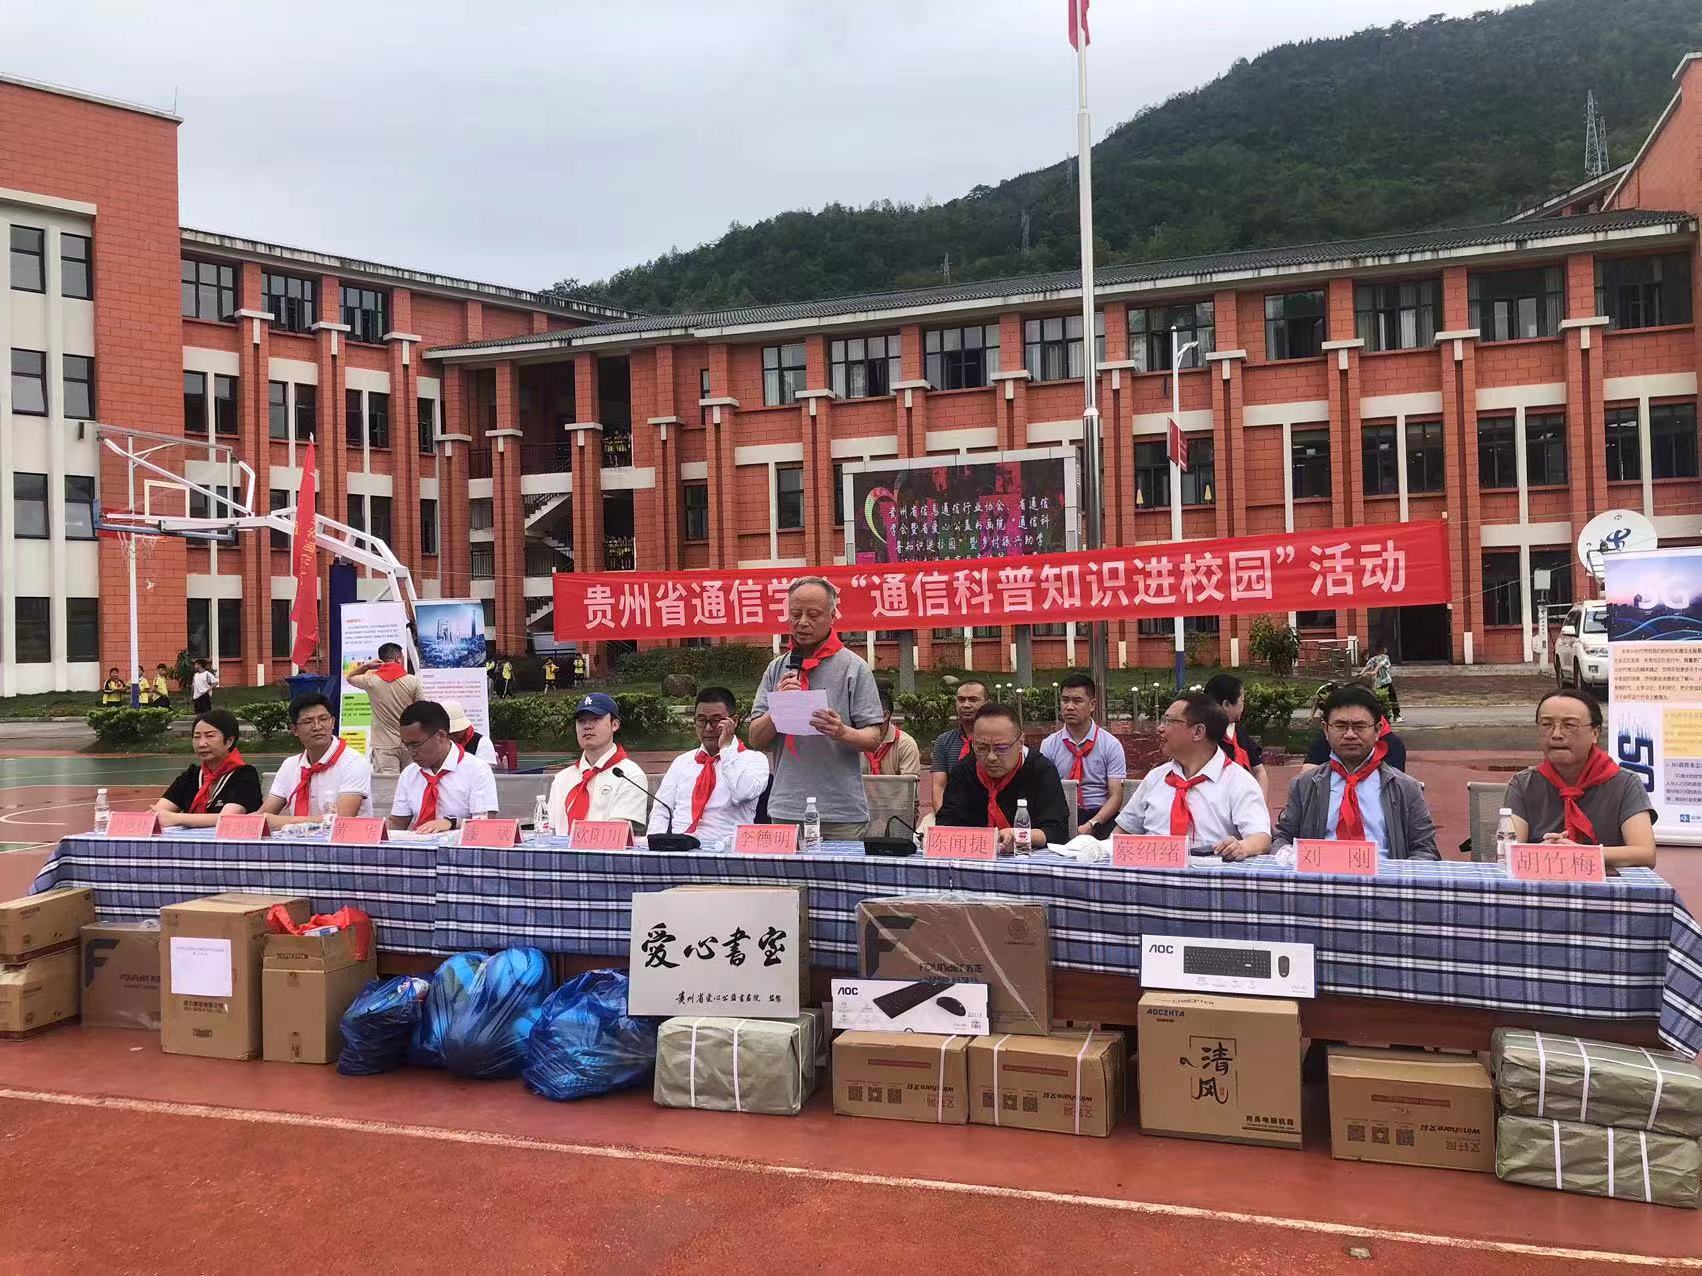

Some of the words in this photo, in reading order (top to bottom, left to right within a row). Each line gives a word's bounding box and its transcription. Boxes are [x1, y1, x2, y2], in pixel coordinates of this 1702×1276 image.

[583, 539, 1407, 630] 贵州省通信学“通信科普知识进校园”活动
[576, 826, 622, 845] 欧阳川
[742, 829, 791, 848] 李德明
[928, 832, 988, 855] 陈闻捷
[1114, 838, 1180, 863] 蔡绍绪
[1516, 850, 1597, 877] 胡竹梅
[1148, 944, 1174, 955] AOC
[837, 987, 859, 995] AOC
[1192, 1041, 1233, 1105] 清风
